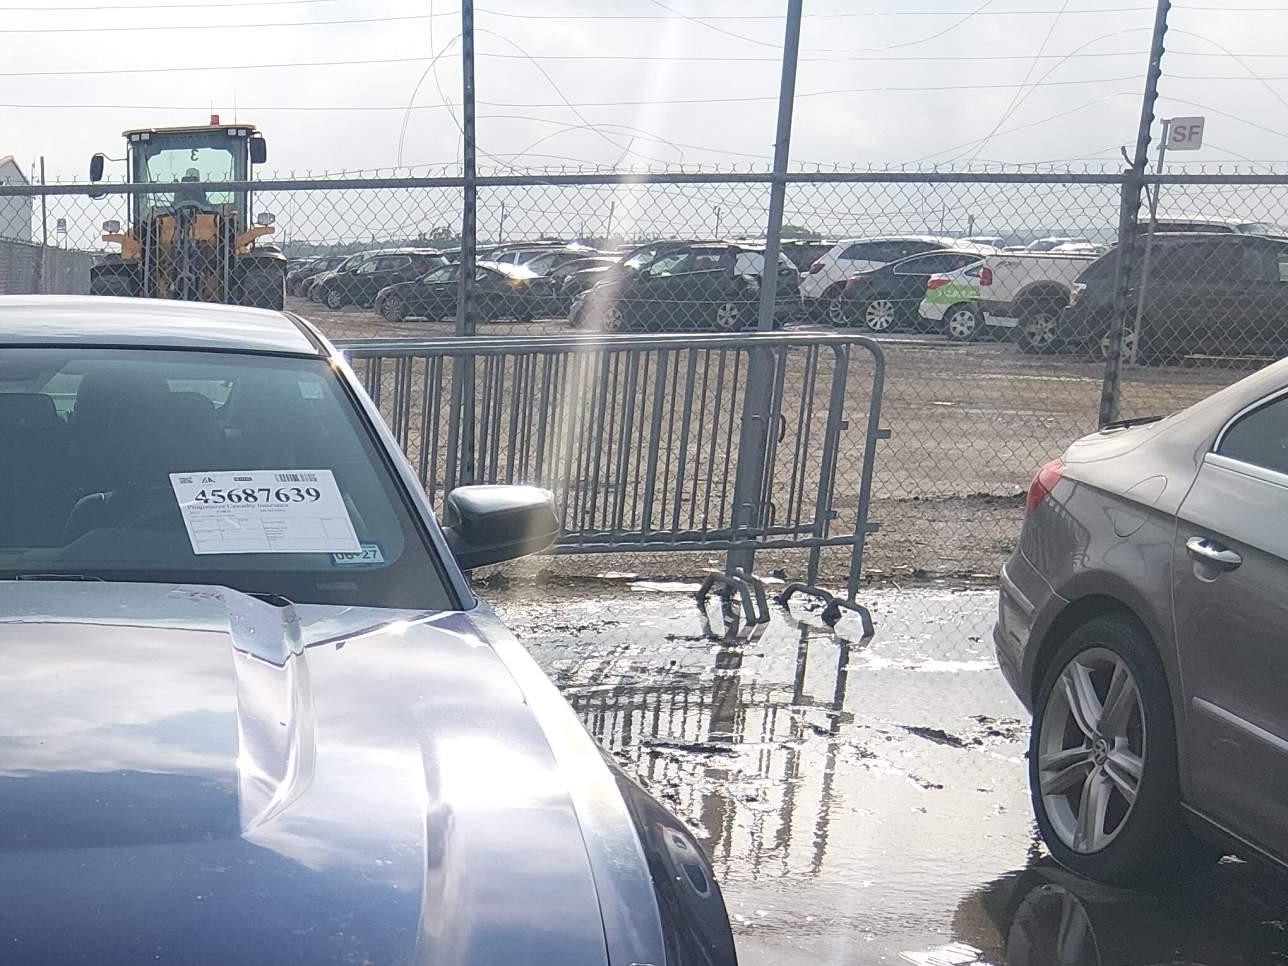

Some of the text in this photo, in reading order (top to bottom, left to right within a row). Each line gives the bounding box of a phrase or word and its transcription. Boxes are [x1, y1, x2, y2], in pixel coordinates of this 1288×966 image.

[1172, 125, 1201, 142] SF
[194, 487, 321, 504] 45687639
[362, 549, 378, 559] 27
